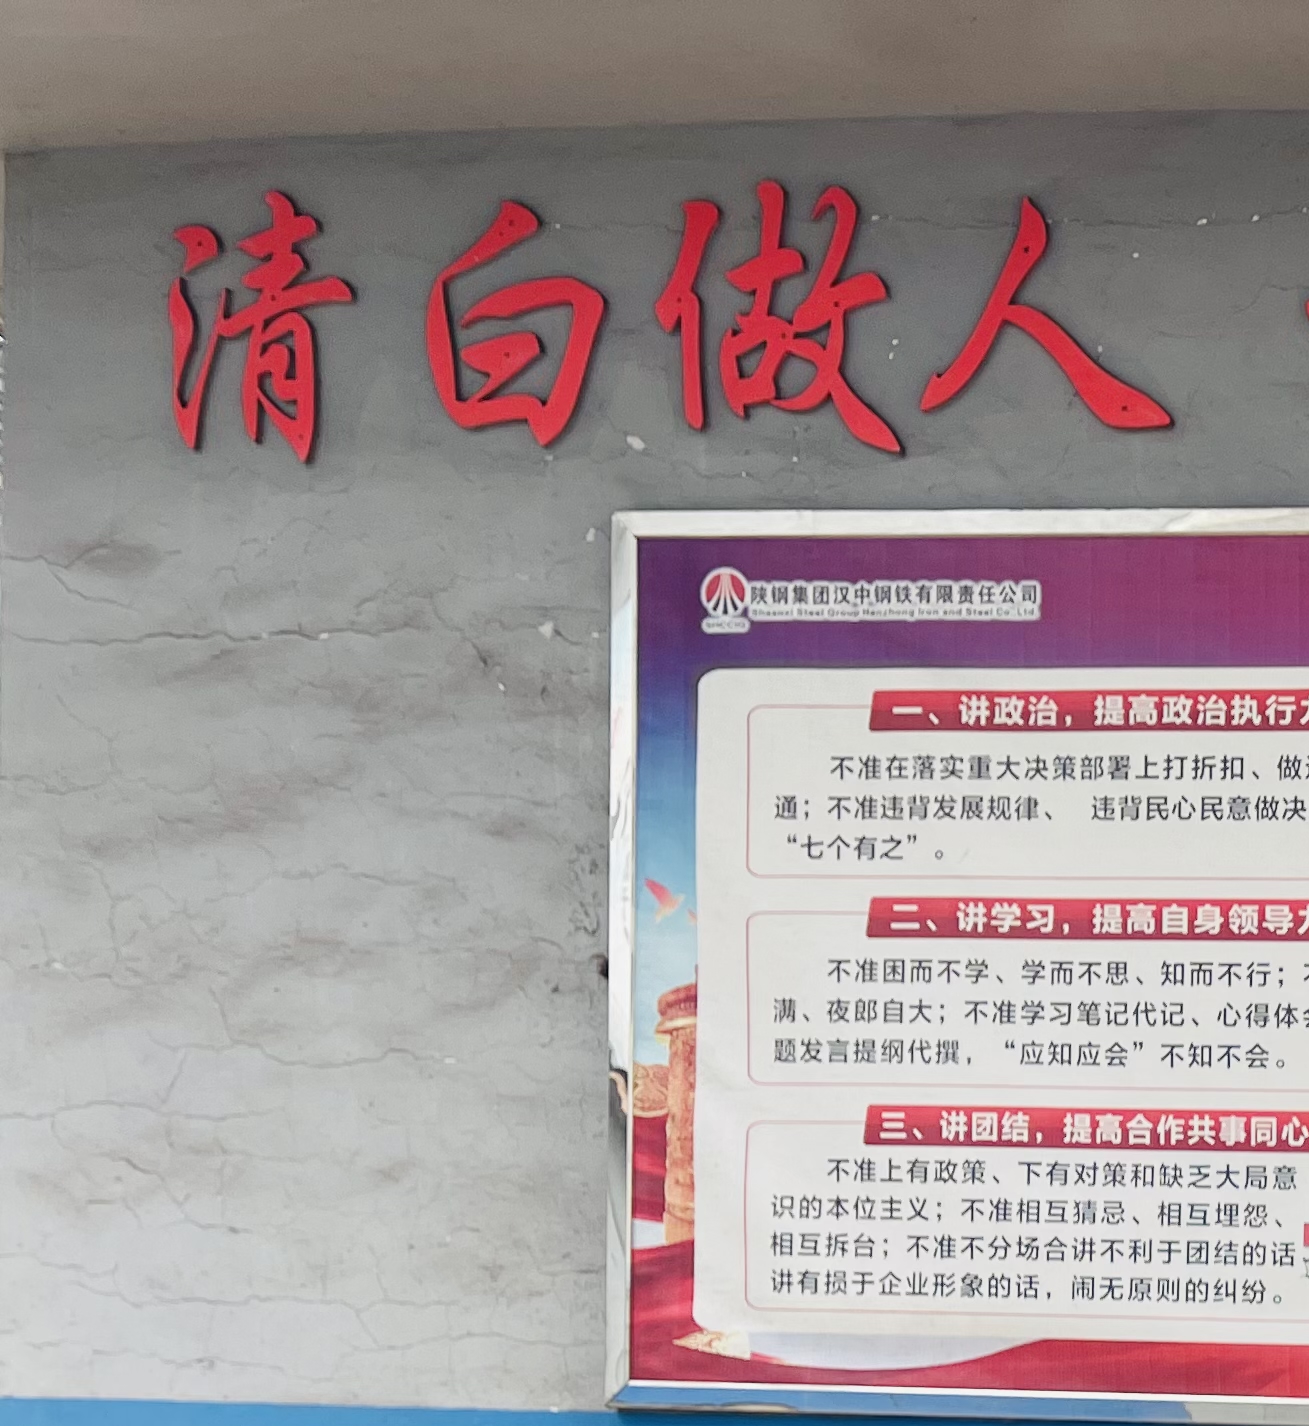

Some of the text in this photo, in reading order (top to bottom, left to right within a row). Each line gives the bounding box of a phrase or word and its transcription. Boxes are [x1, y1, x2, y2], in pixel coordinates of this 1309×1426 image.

[168, 190, 1175, 463] 清白做人
[750, 583, 1038, 605] 陕钢集团汉中钢铁有限责任公司
[826, 1157, 1298, 1191] 不准上有政策、下有对策和缺乏大局意
[771, 1194, 1284, 1229] 识的本位主义；不准相互猜忌、相互埋怨、
[770, 1231, 1297, 1268] 相互拆台；不准不分场合讲不利于团结的话
[771, 1268, 1283, 1306] 讲有损于企业形象的话，闹无原则的纠纷。
